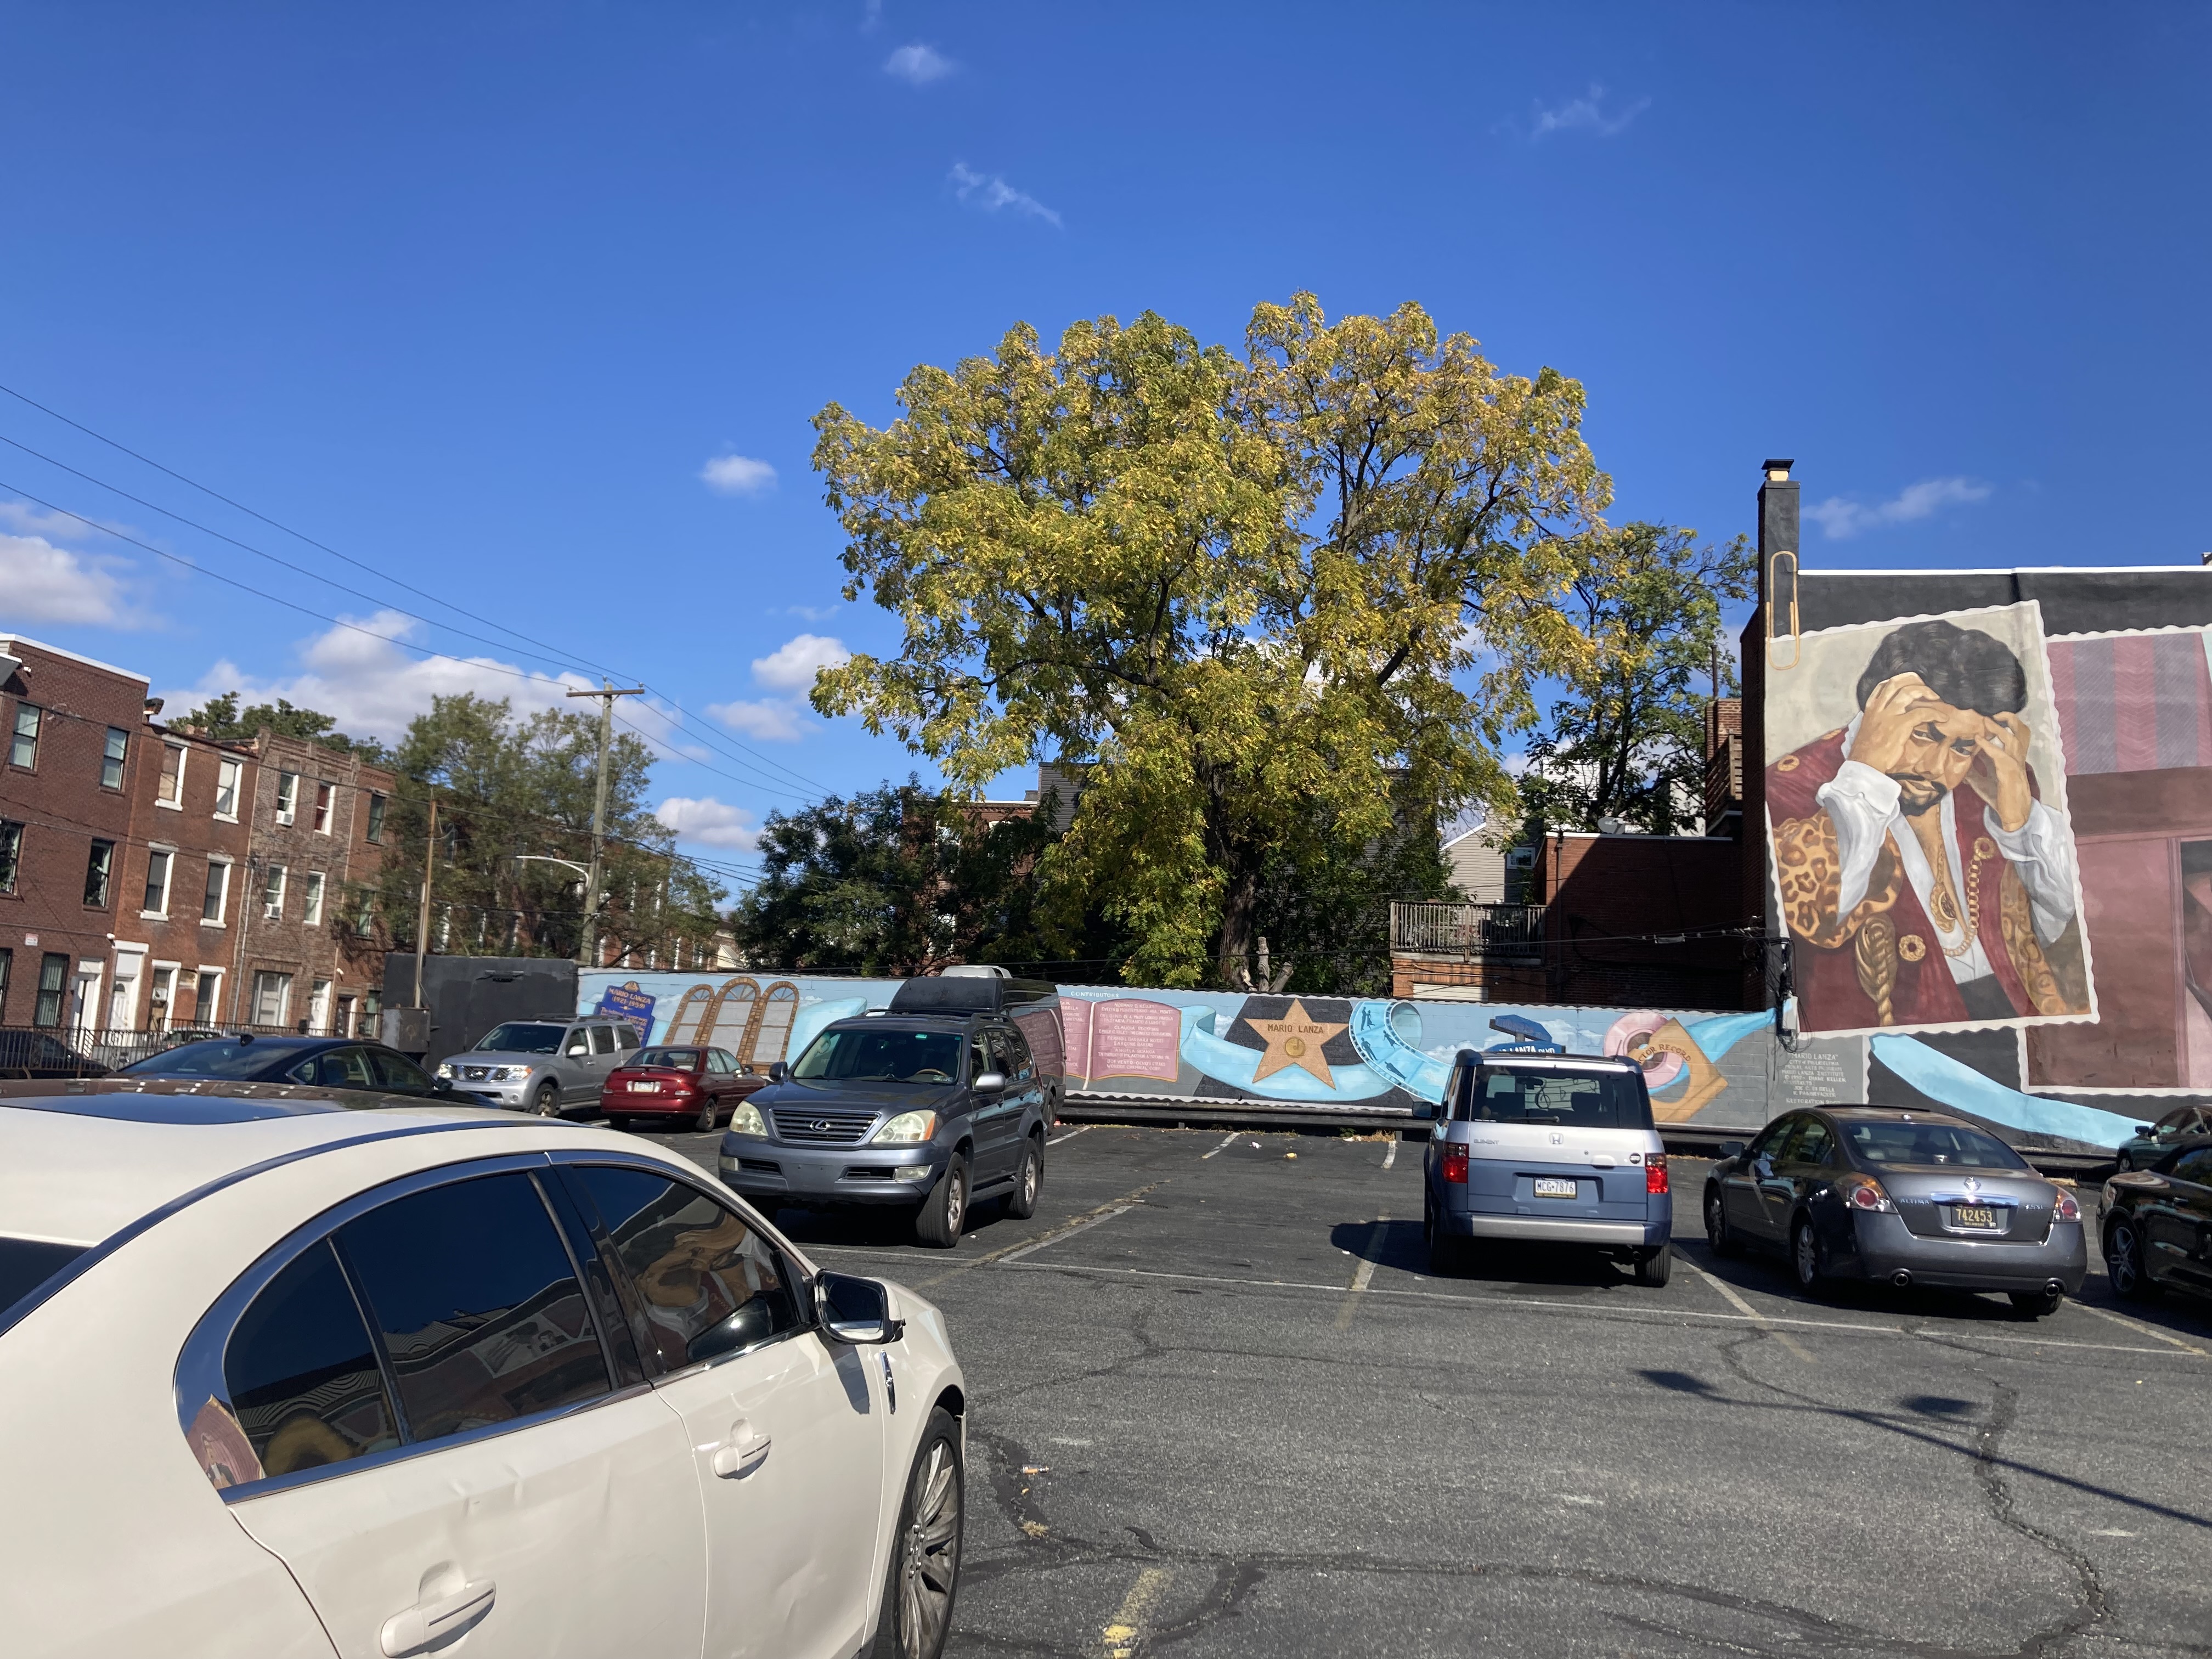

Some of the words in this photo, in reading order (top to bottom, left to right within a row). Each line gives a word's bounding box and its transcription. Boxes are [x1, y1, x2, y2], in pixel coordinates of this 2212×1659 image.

[608, 988, 629, 997] MARIO
[630, 994, 651, 1004] LANZA
[1267, 1024, 1293, 1032] MARIO
[1299, 1025, 1324, 1034] LANZA
[1658, 1044, 1691, 1062] RECORD
[1955, 1209, 1993, 1223] 742453
